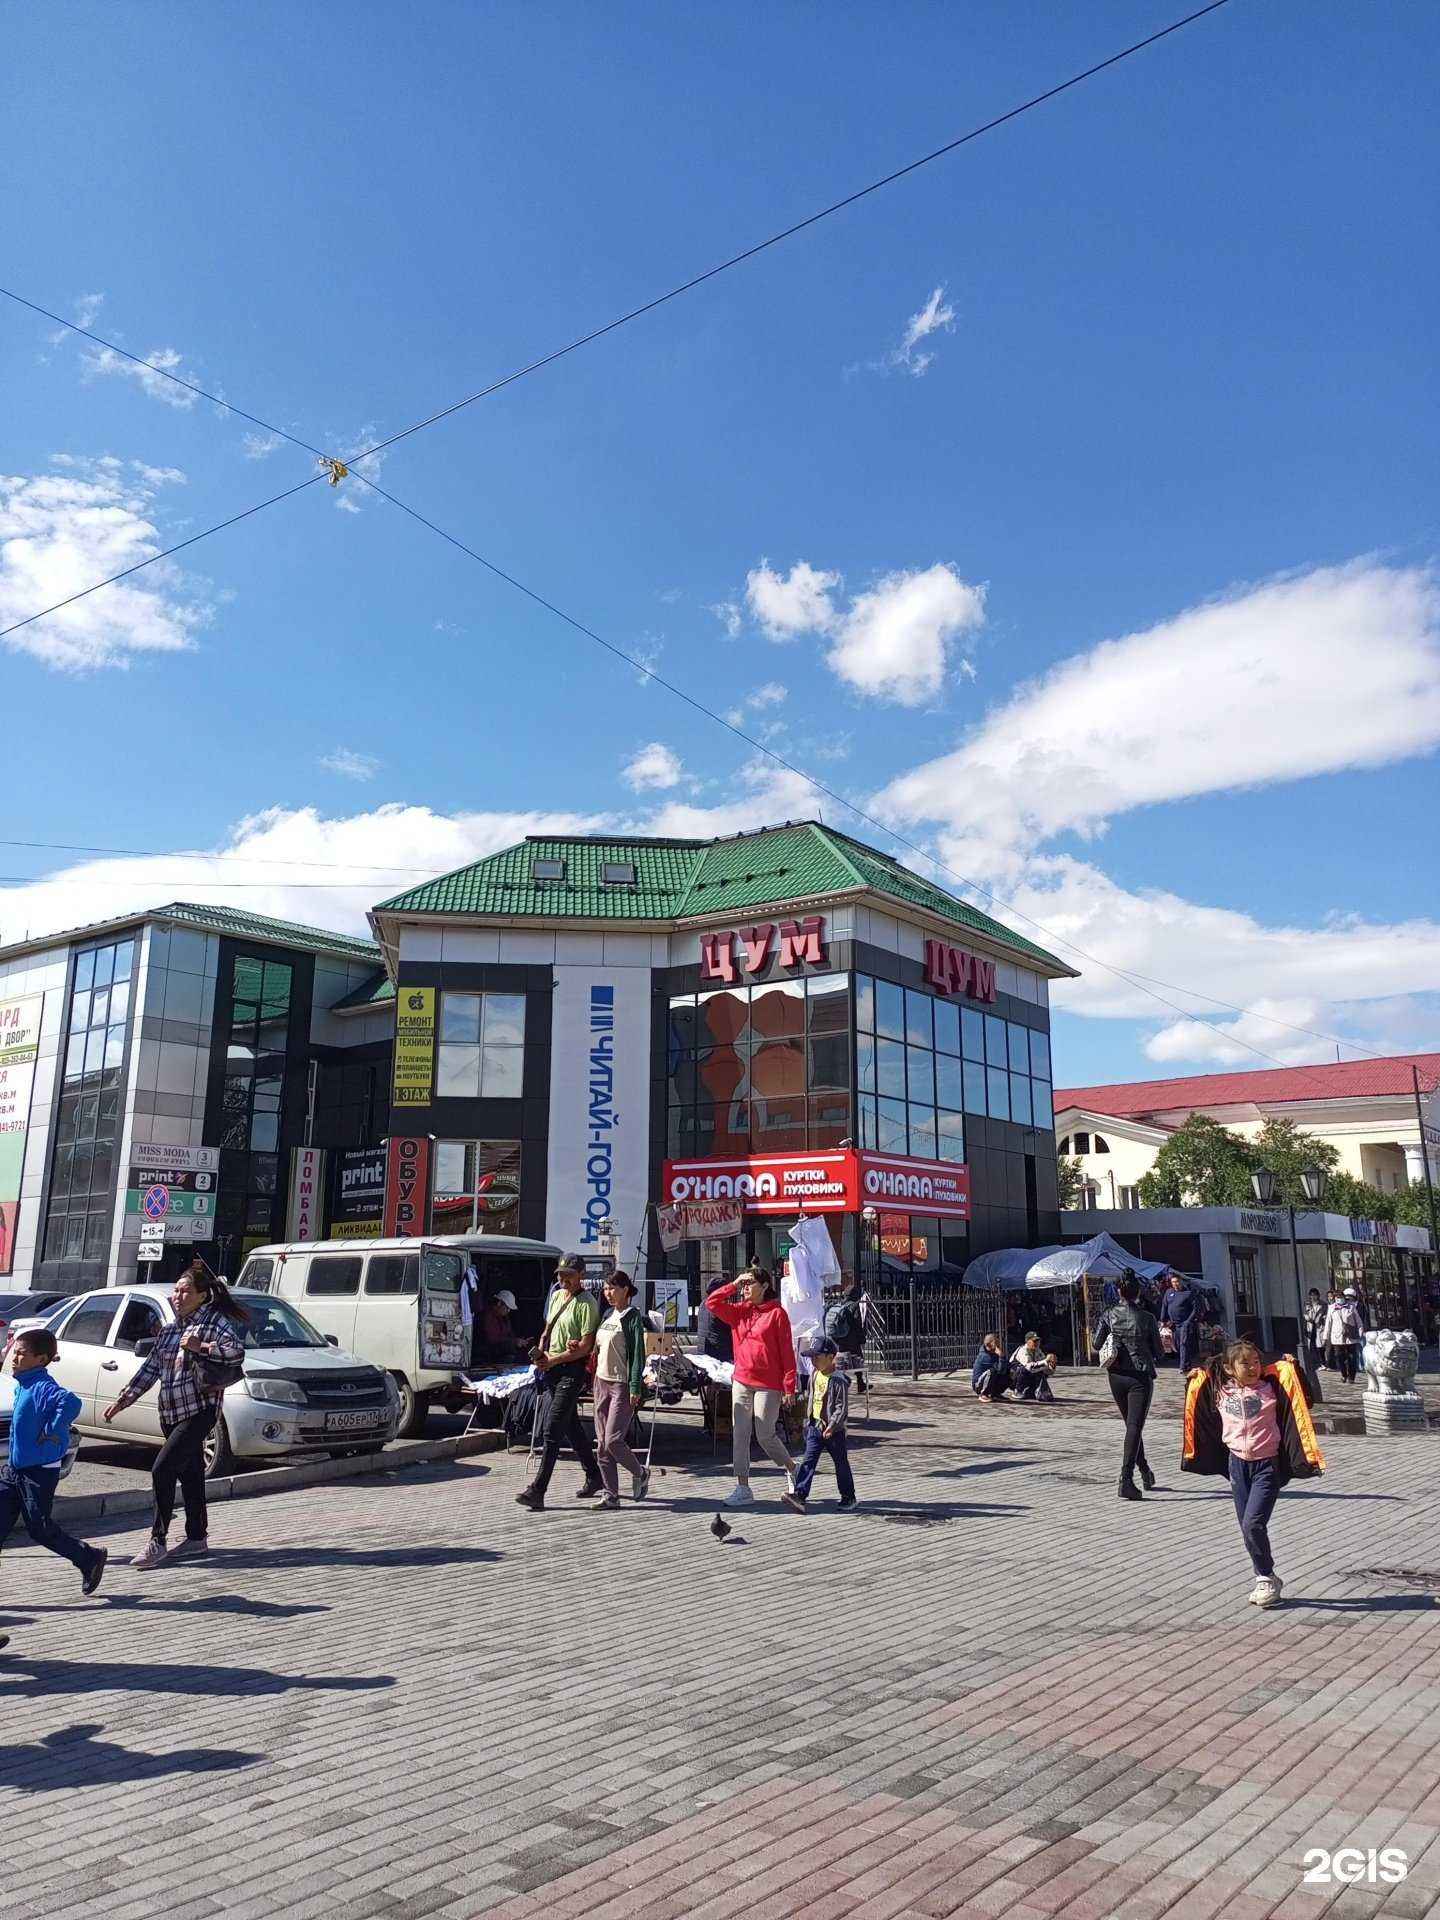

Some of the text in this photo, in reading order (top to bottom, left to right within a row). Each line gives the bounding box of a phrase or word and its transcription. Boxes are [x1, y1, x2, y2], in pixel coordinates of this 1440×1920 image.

[701, 915, 826, 982] ЦУМ
[926, 939, 996, 1003] ЦУМ
[399, 1016, 433, 1027] РЕМОНТ
[399, 1037, 432, 1047] ТЕХНИКИ
[402, 1088, 430, 1102] ЭТАЖ
[580, 1035, 619, 1244] ЧИТАЙ-ГОРОД
[138, 1146, 161, 1156] MISS
[163, 1148, 191, 1159] MODA
[201, 1152, 208, 1161] 3
[138, 1170, 207, 1185] print 2
[342, 1161, 383, 1190] print
[783, 1170, 826, 1182] КУРТКИ
[671, 1172, 777, 1200] O'HARA
[783, 1182, 843, 1195] ПУХОВИКИ
[864, 1169, 933, 1199] O'HARA
[934, 1178, 957, 1189] КУРТКИ
[299, 1151, 314, 1240] ЛОМБАР
[935, 1190, 967, 1203] ПУХОВИКИ
